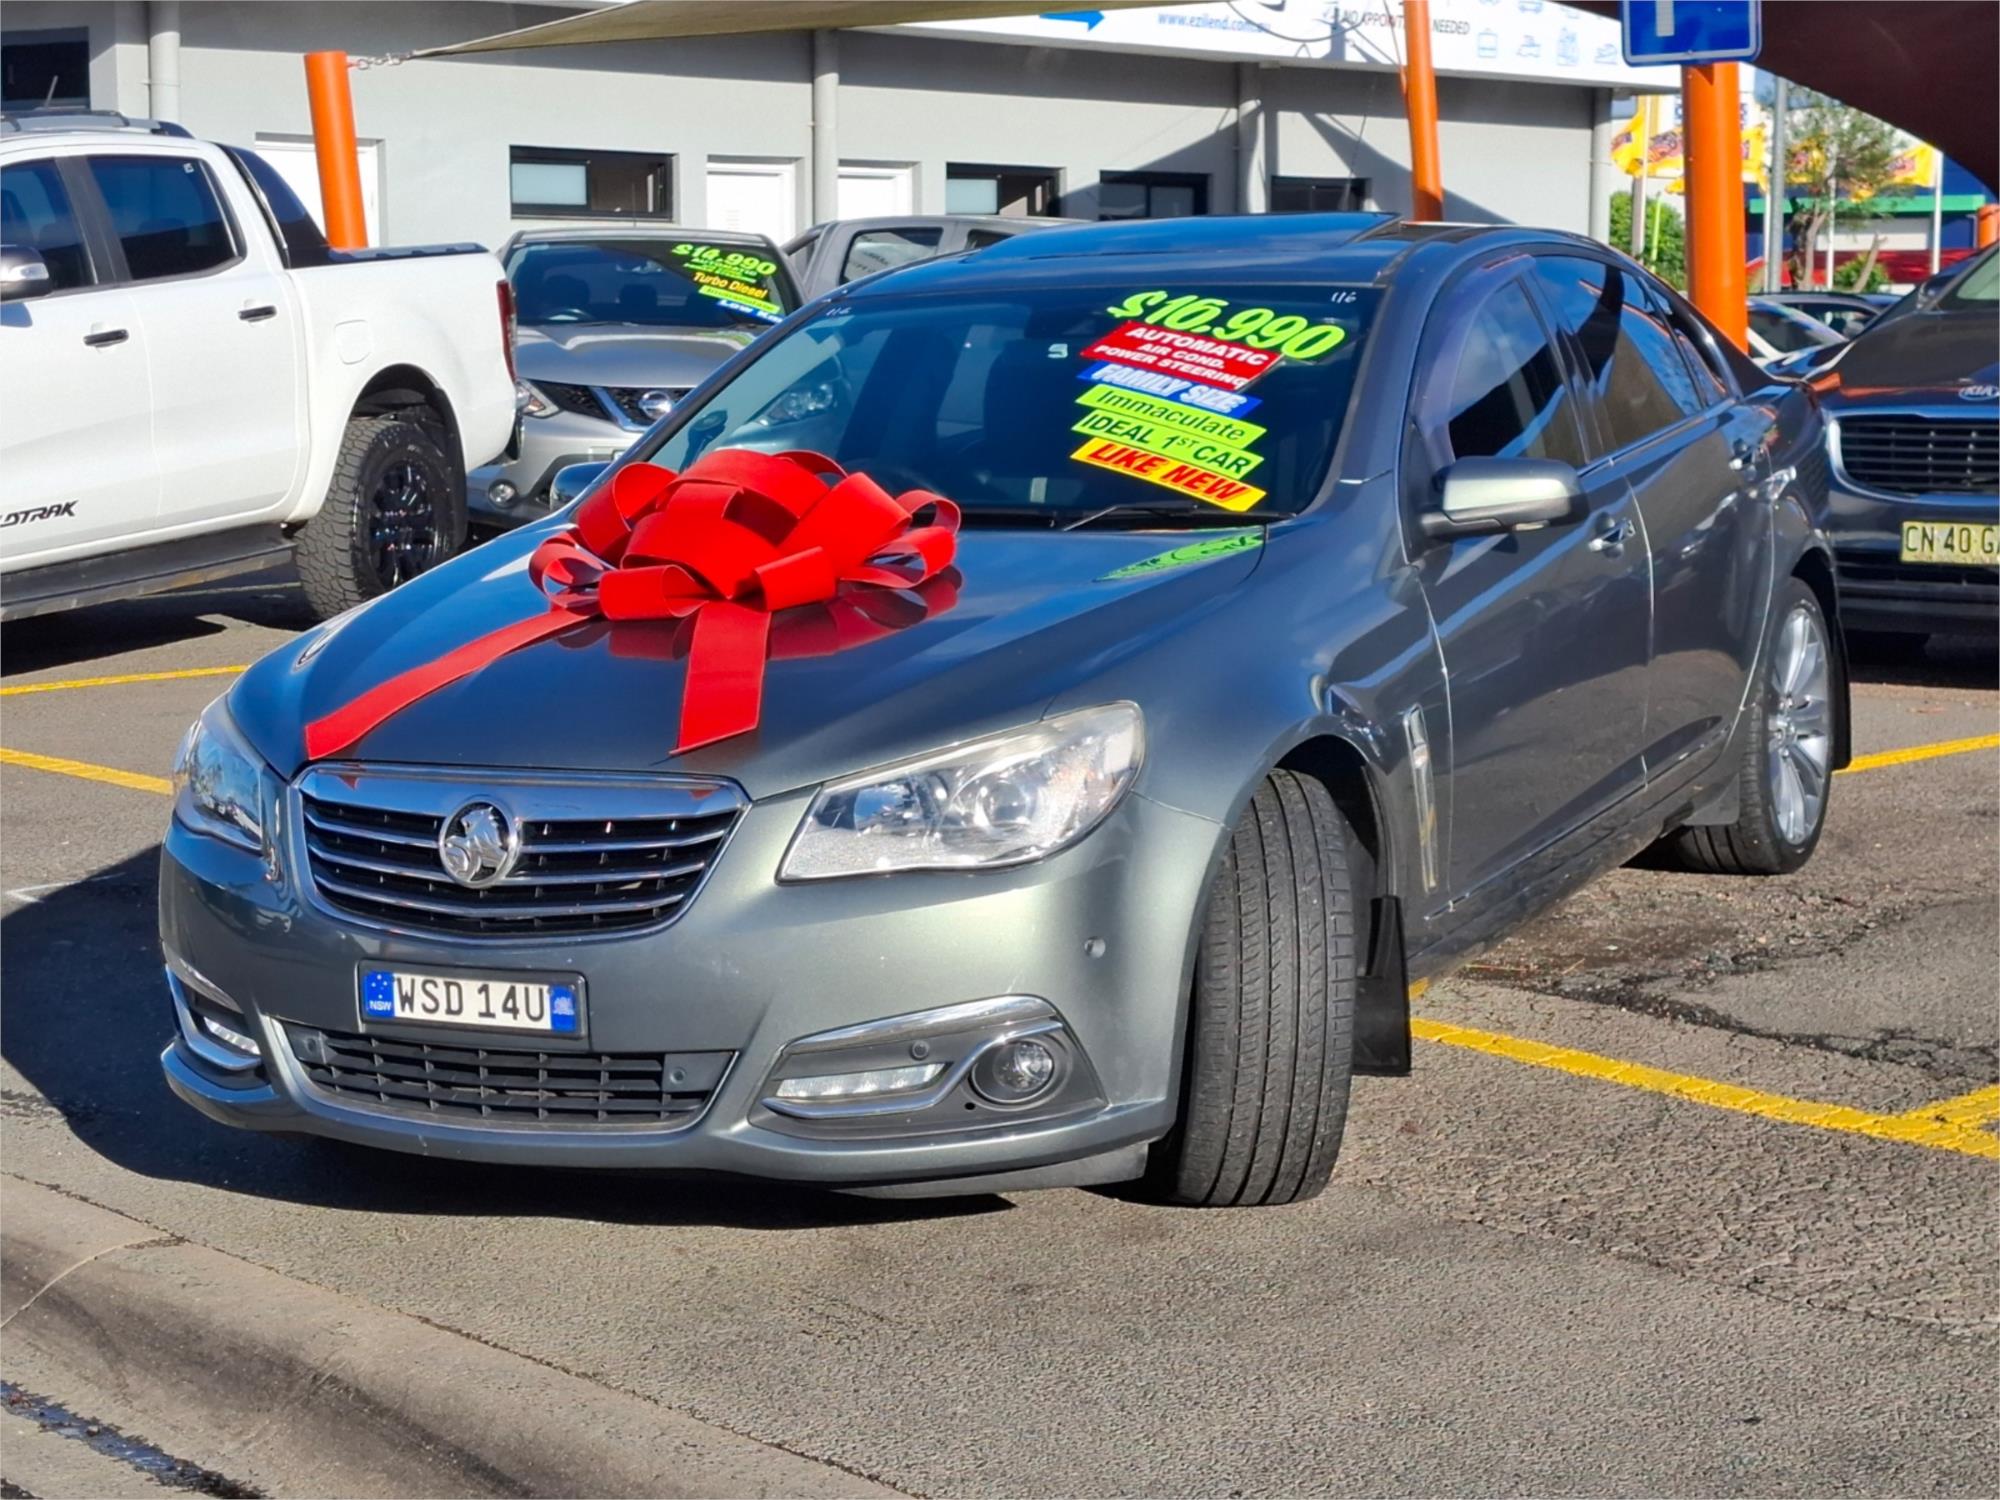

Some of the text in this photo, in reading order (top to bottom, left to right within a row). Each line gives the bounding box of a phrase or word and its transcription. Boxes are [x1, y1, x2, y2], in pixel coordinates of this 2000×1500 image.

[1362, 12, 1405, 29] APPOINT
[1432, 19, 1470, 35] NEEDED
[693, 271, 729, 289] Turbo
[728, 281, 769, 299] Diesel
[1107, 290, 1345, 359] $16.990
[1094, 345, 1250, 388] POWER STEERING
[1126, 327, 1270, 366] AUTOMATIC
[1138, 343, 1225, 370] AIR COND.
[1091, 363, 1248, 413] FAMILY SIZE
[1097, 390, 1245, 441] Immaculate
[1083, 413, 1156, 444] IDEAL
[1192, 445, 1252, 475] CAR
[1087, 443, 1250, 502] LIKE NEW
[0, 500, 79, 528] DTRAK
[1905, 526, 1935, 553] CN
[1943, 527, 1972, 554] 40
[369, 1000, 392, 1011] NSW
[396, 976, 545, 1023] WSD 14U
